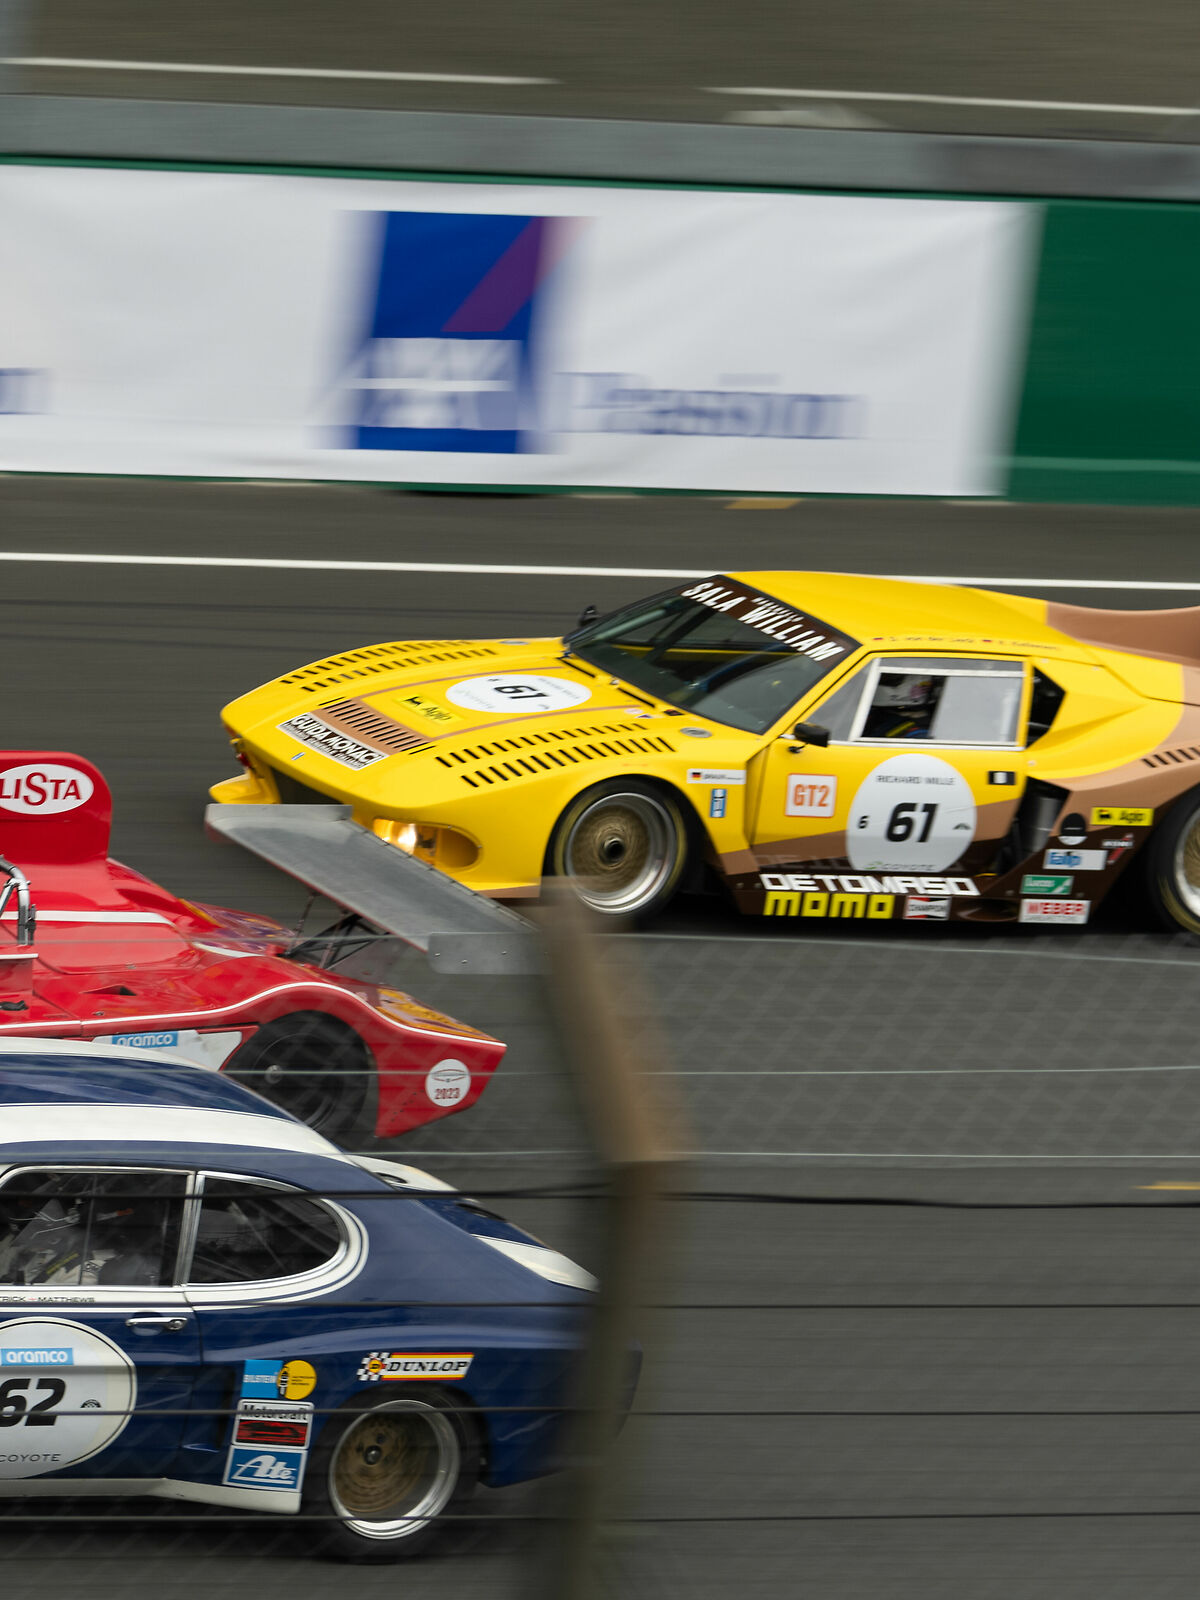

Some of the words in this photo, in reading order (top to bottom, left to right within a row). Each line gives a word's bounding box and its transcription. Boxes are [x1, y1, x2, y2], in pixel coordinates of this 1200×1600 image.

[681, 582, 748, 612] SALA
[738, 602, 846, 662] WILLIAM
[493, 685, 548, 700] 61
[288, 713, 335, 740] GUIDA
[794, 784, 830, 807] GT2
[858, 815, 869, 829] 6
[886, 802, 939, 843] 61
[117, 1034, 173, 1047] aramco
[435, 1087, 460, 1100] 2023
[6, 1351, 69, 1363] aramco
[387, 1361, 470, 1372] DUNLOP
